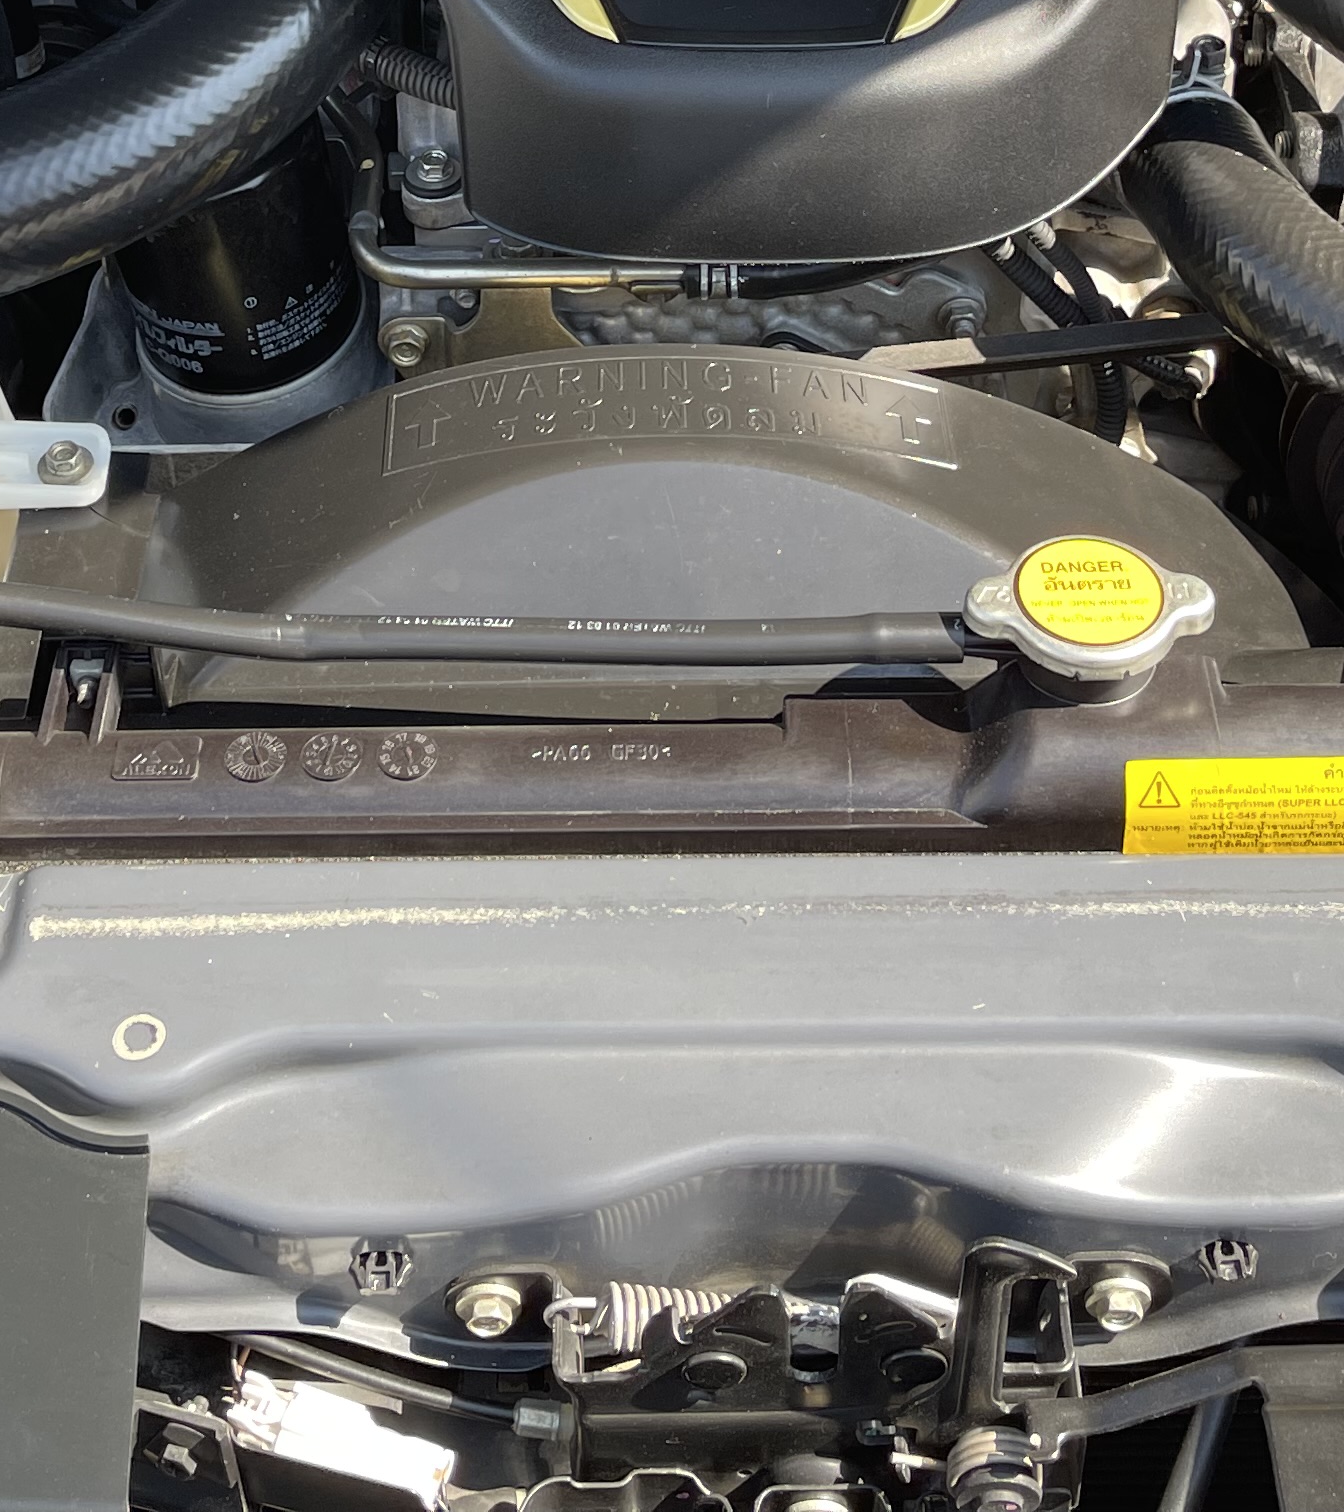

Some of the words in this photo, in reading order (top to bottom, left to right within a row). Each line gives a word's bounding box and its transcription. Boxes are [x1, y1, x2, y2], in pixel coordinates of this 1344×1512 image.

[492, 396, 822, 440] ระวังพัดลม
[1040, 561, 1124, 574] DANGER
